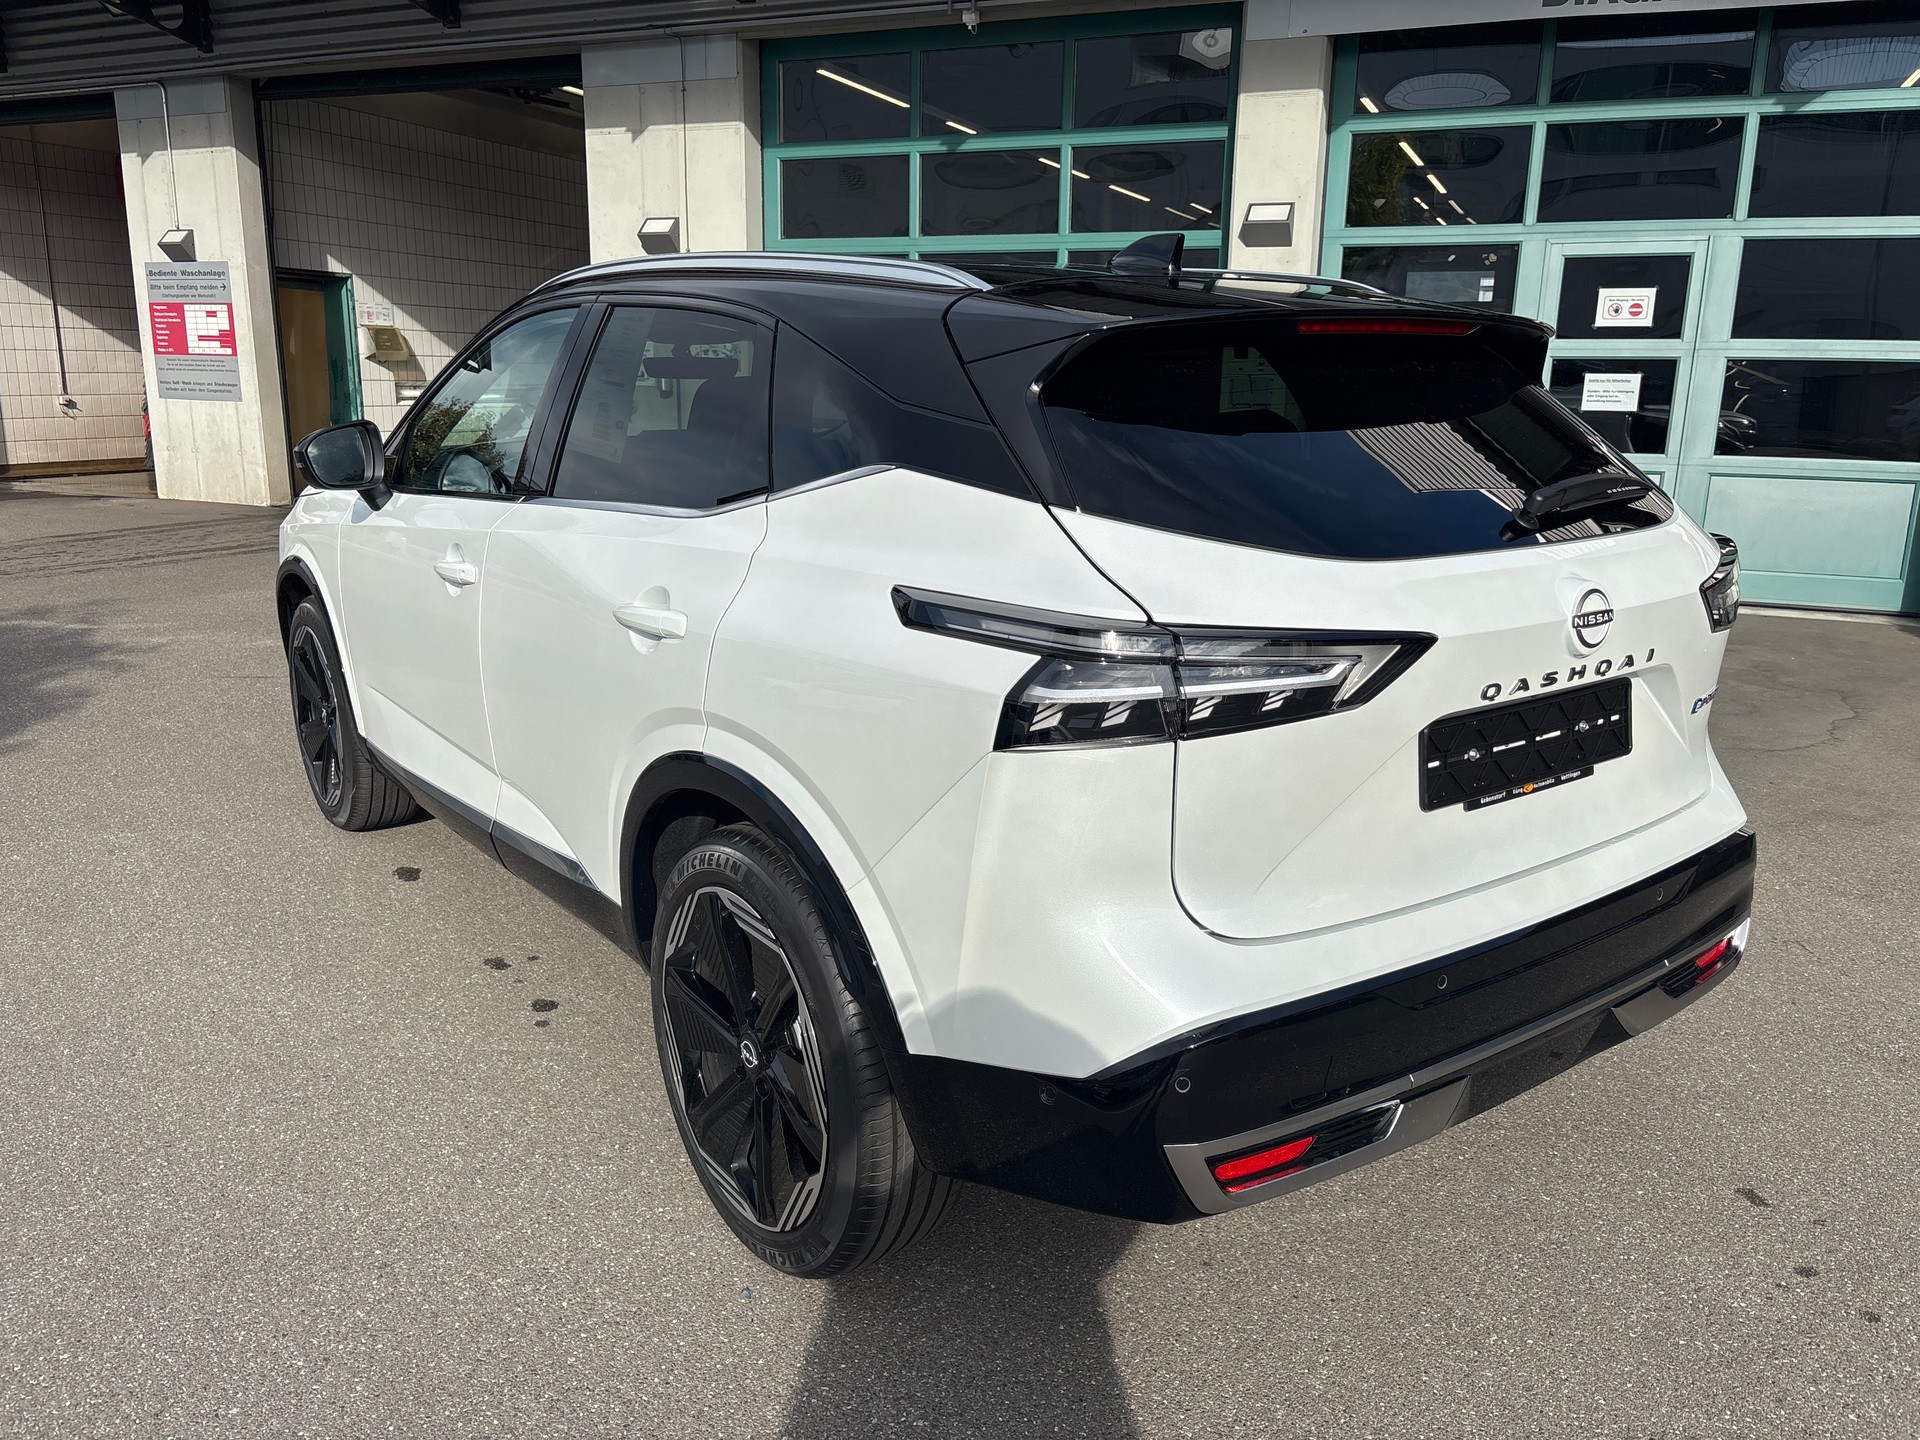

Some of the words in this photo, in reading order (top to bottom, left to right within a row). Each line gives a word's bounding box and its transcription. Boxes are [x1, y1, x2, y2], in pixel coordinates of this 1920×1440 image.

[149, 269, 178, 277] Bediente
[180, 269, 226, 278] Waschanlage
[1574, 611, 1614, 627] NISSAN
[1480, 648, 1655, 702] QASHQAI
[1561, 770, 1581, 781] Wettingen
[677, 852, 743, 882] MICHELIN
